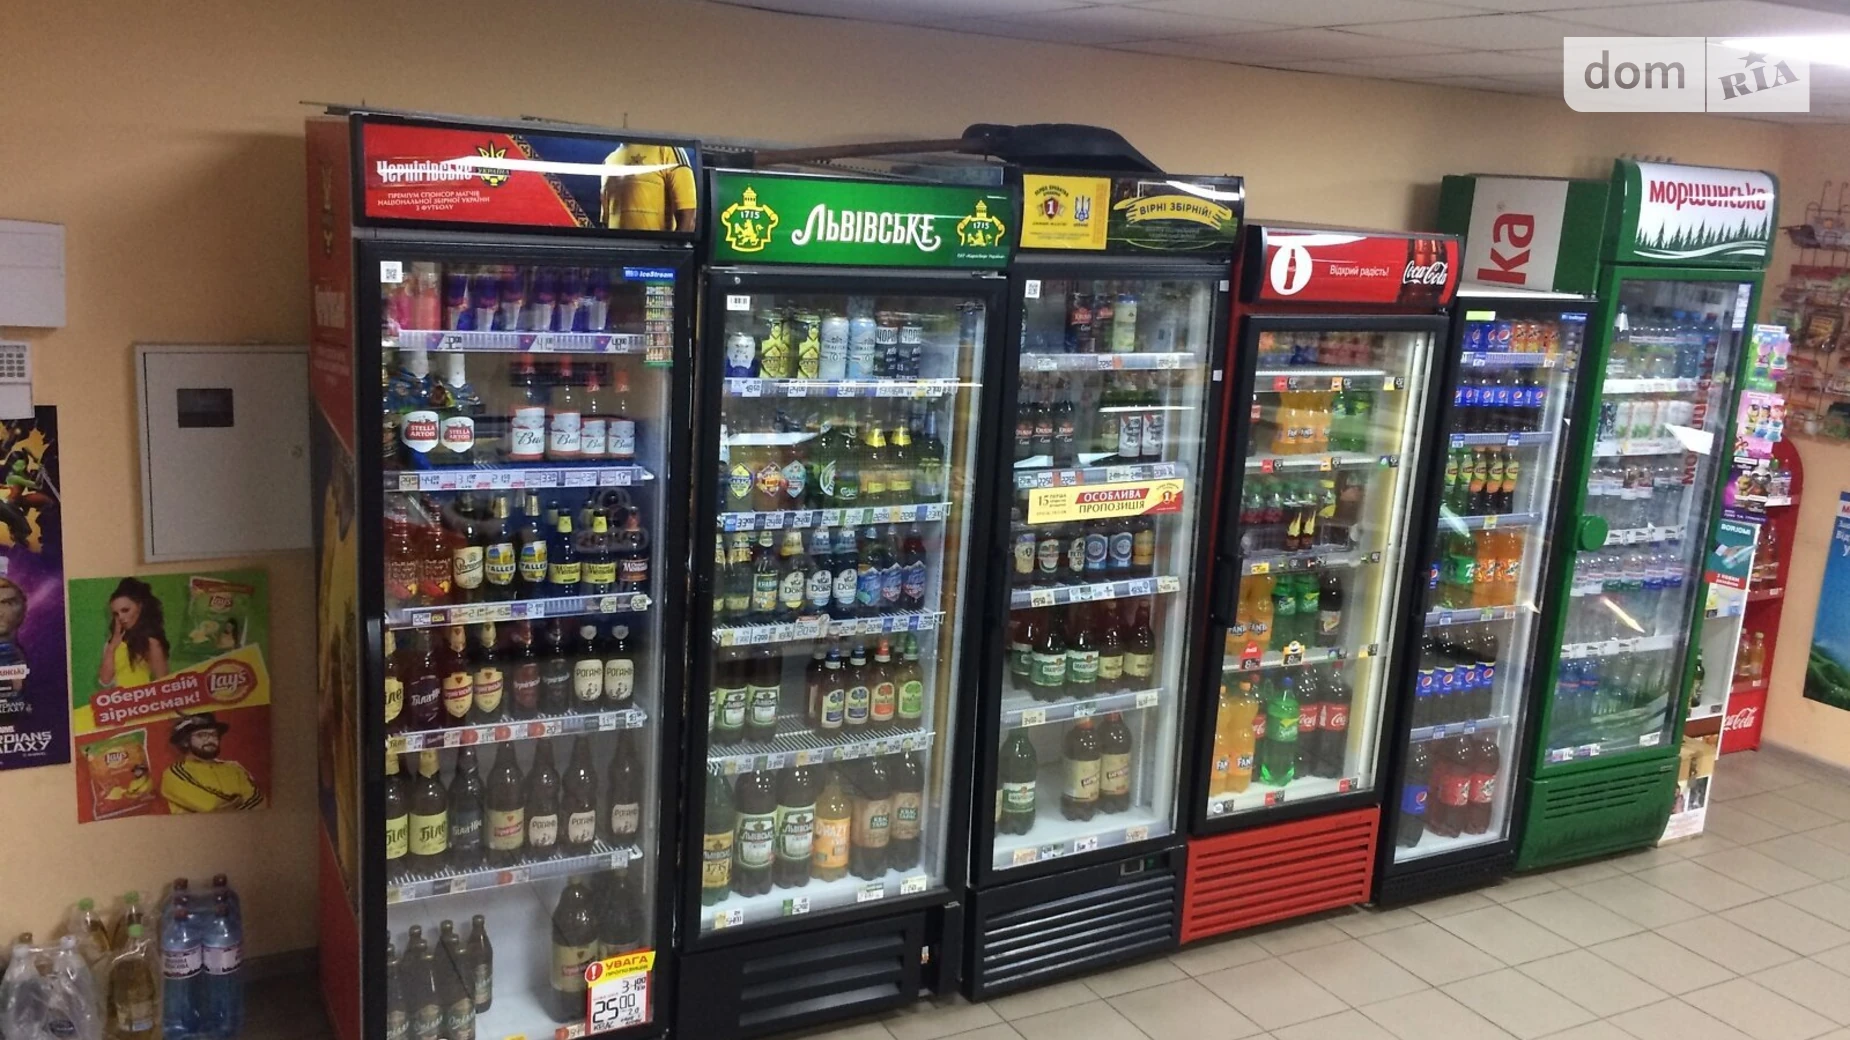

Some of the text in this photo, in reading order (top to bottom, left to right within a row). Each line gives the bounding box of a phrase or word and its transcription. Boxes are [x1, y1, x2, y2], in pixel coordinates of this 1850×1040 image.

[420, 191, 454, 199] СПОНСОР
[740, 211, 760, 219] 1715
[1139, 202, 1212, 218] ВІРНІ ЗБІРНІЙ!
[973, 221, 990, 229] 1715
[1330, 264, 1390, 277] Відкрий радість!
[1083, 489, 1141, 502] ОСОБЛИВА
[1079, 501, 1145, 514] ПРОПОЗИЦІЯ
[96, 676, 199, 707] Обери свій
[99, 692, 201, 723] зіркосмак!
[0, 731, 52, 744] DIANS
[605, 955, 648, 970] УВАГА
